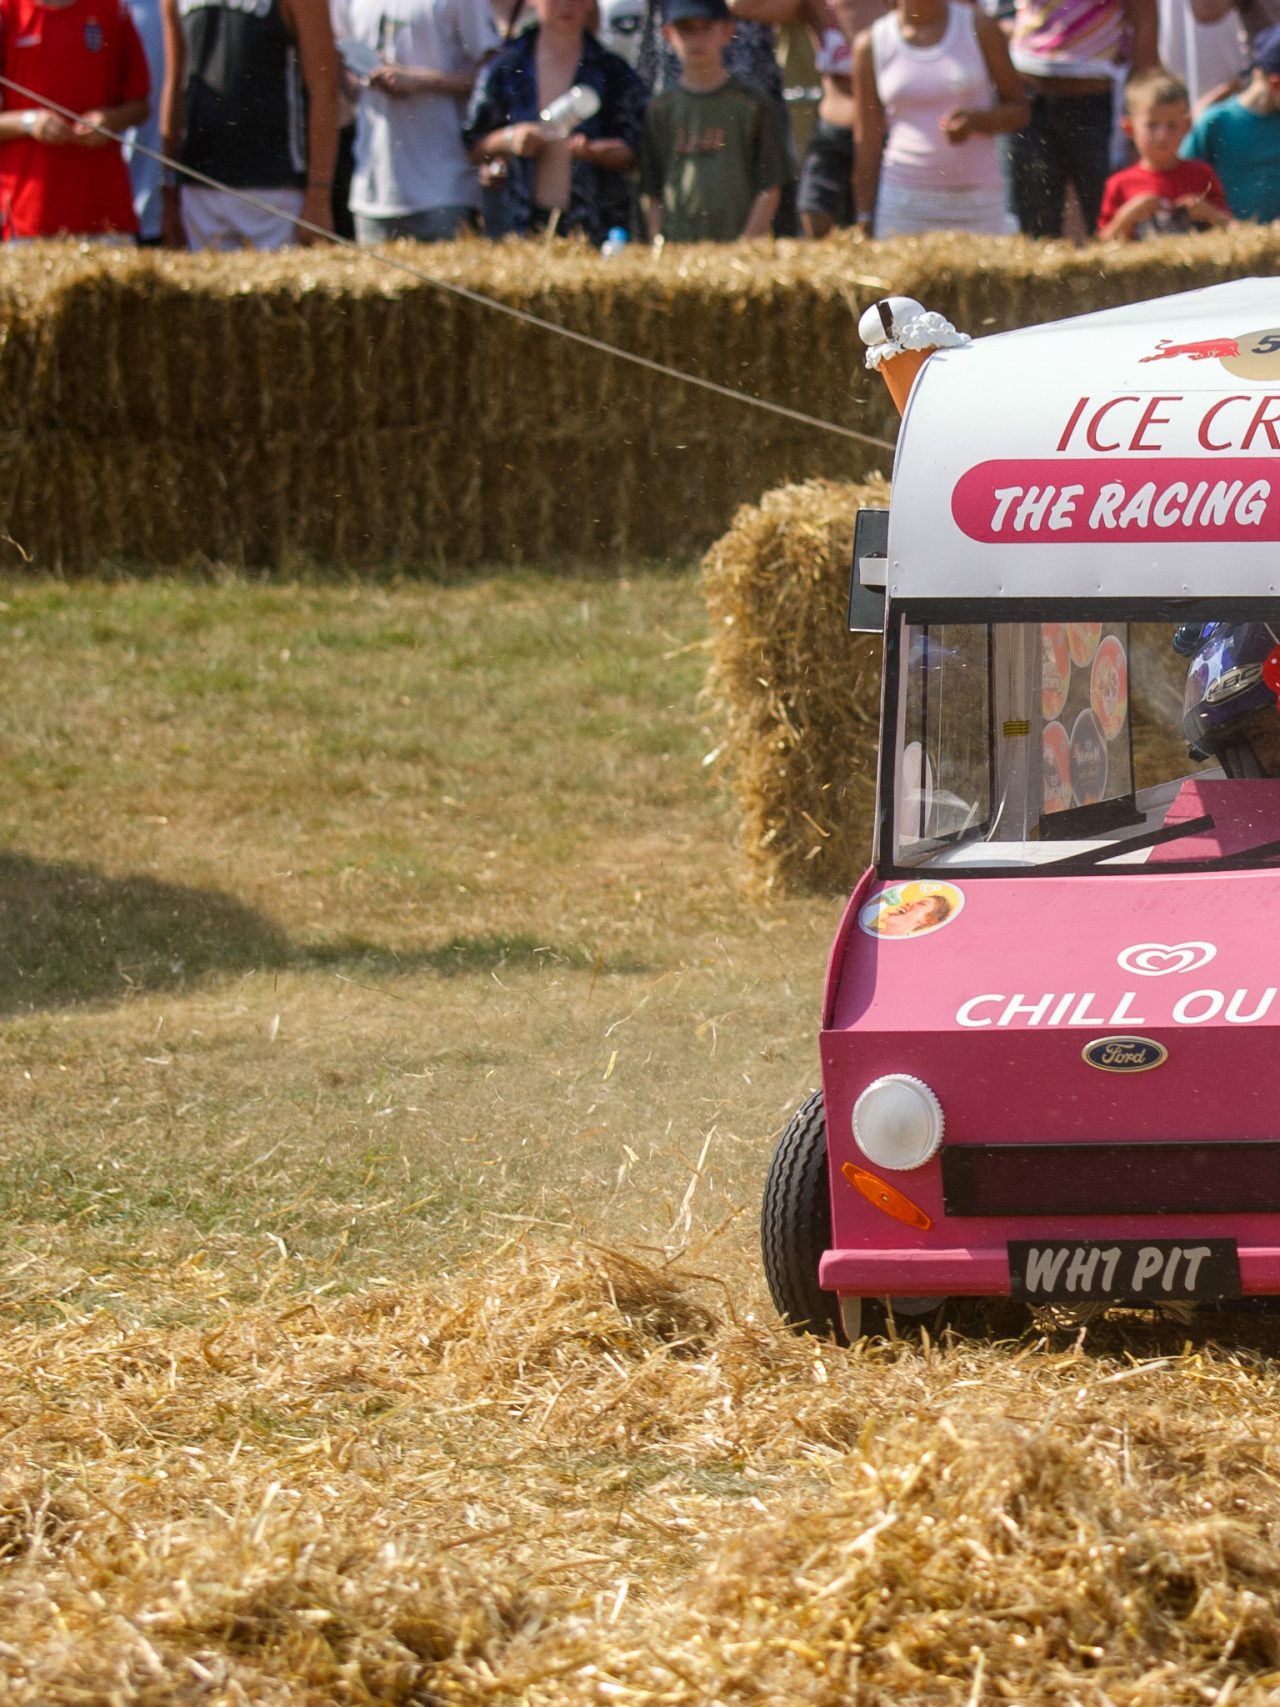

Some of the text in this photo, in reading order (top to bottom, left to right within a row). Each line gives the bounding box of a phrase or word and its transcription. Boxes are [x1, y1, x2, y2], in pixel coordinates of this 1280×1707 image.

[1056, 396, 1184, 452] ICE
[991, 484, 1084, 531] THE
[1089, 479, 1271, 529] RACING
[955, 992, 1147, 1028] CHILL
[1101, 1043, 1147, 1065] Ford
[1025, 1246, 1212, 1293] WH1 PIT
